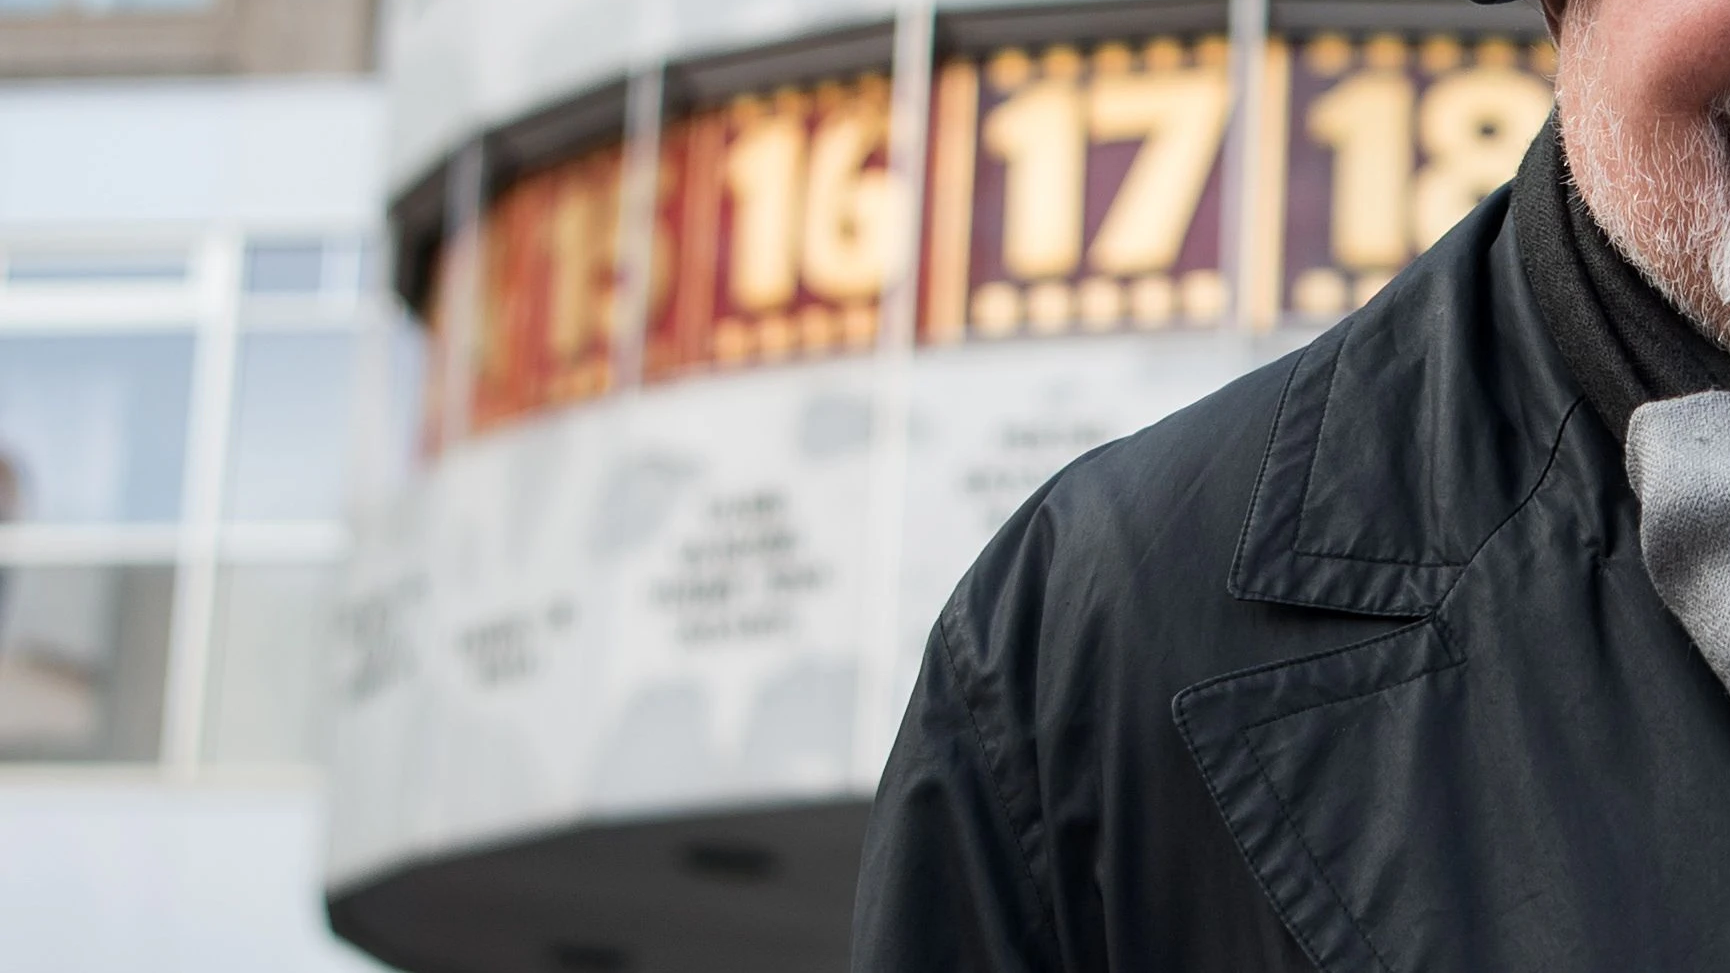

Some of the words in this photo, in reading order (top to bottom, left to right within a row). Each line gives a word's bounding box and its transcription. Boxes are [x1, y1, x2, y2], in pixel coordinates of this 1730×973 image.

[726, 111, 914, 315] 16
[983, 73, 1234, 279] 17
[1309, 67, 1556, 271] 18
